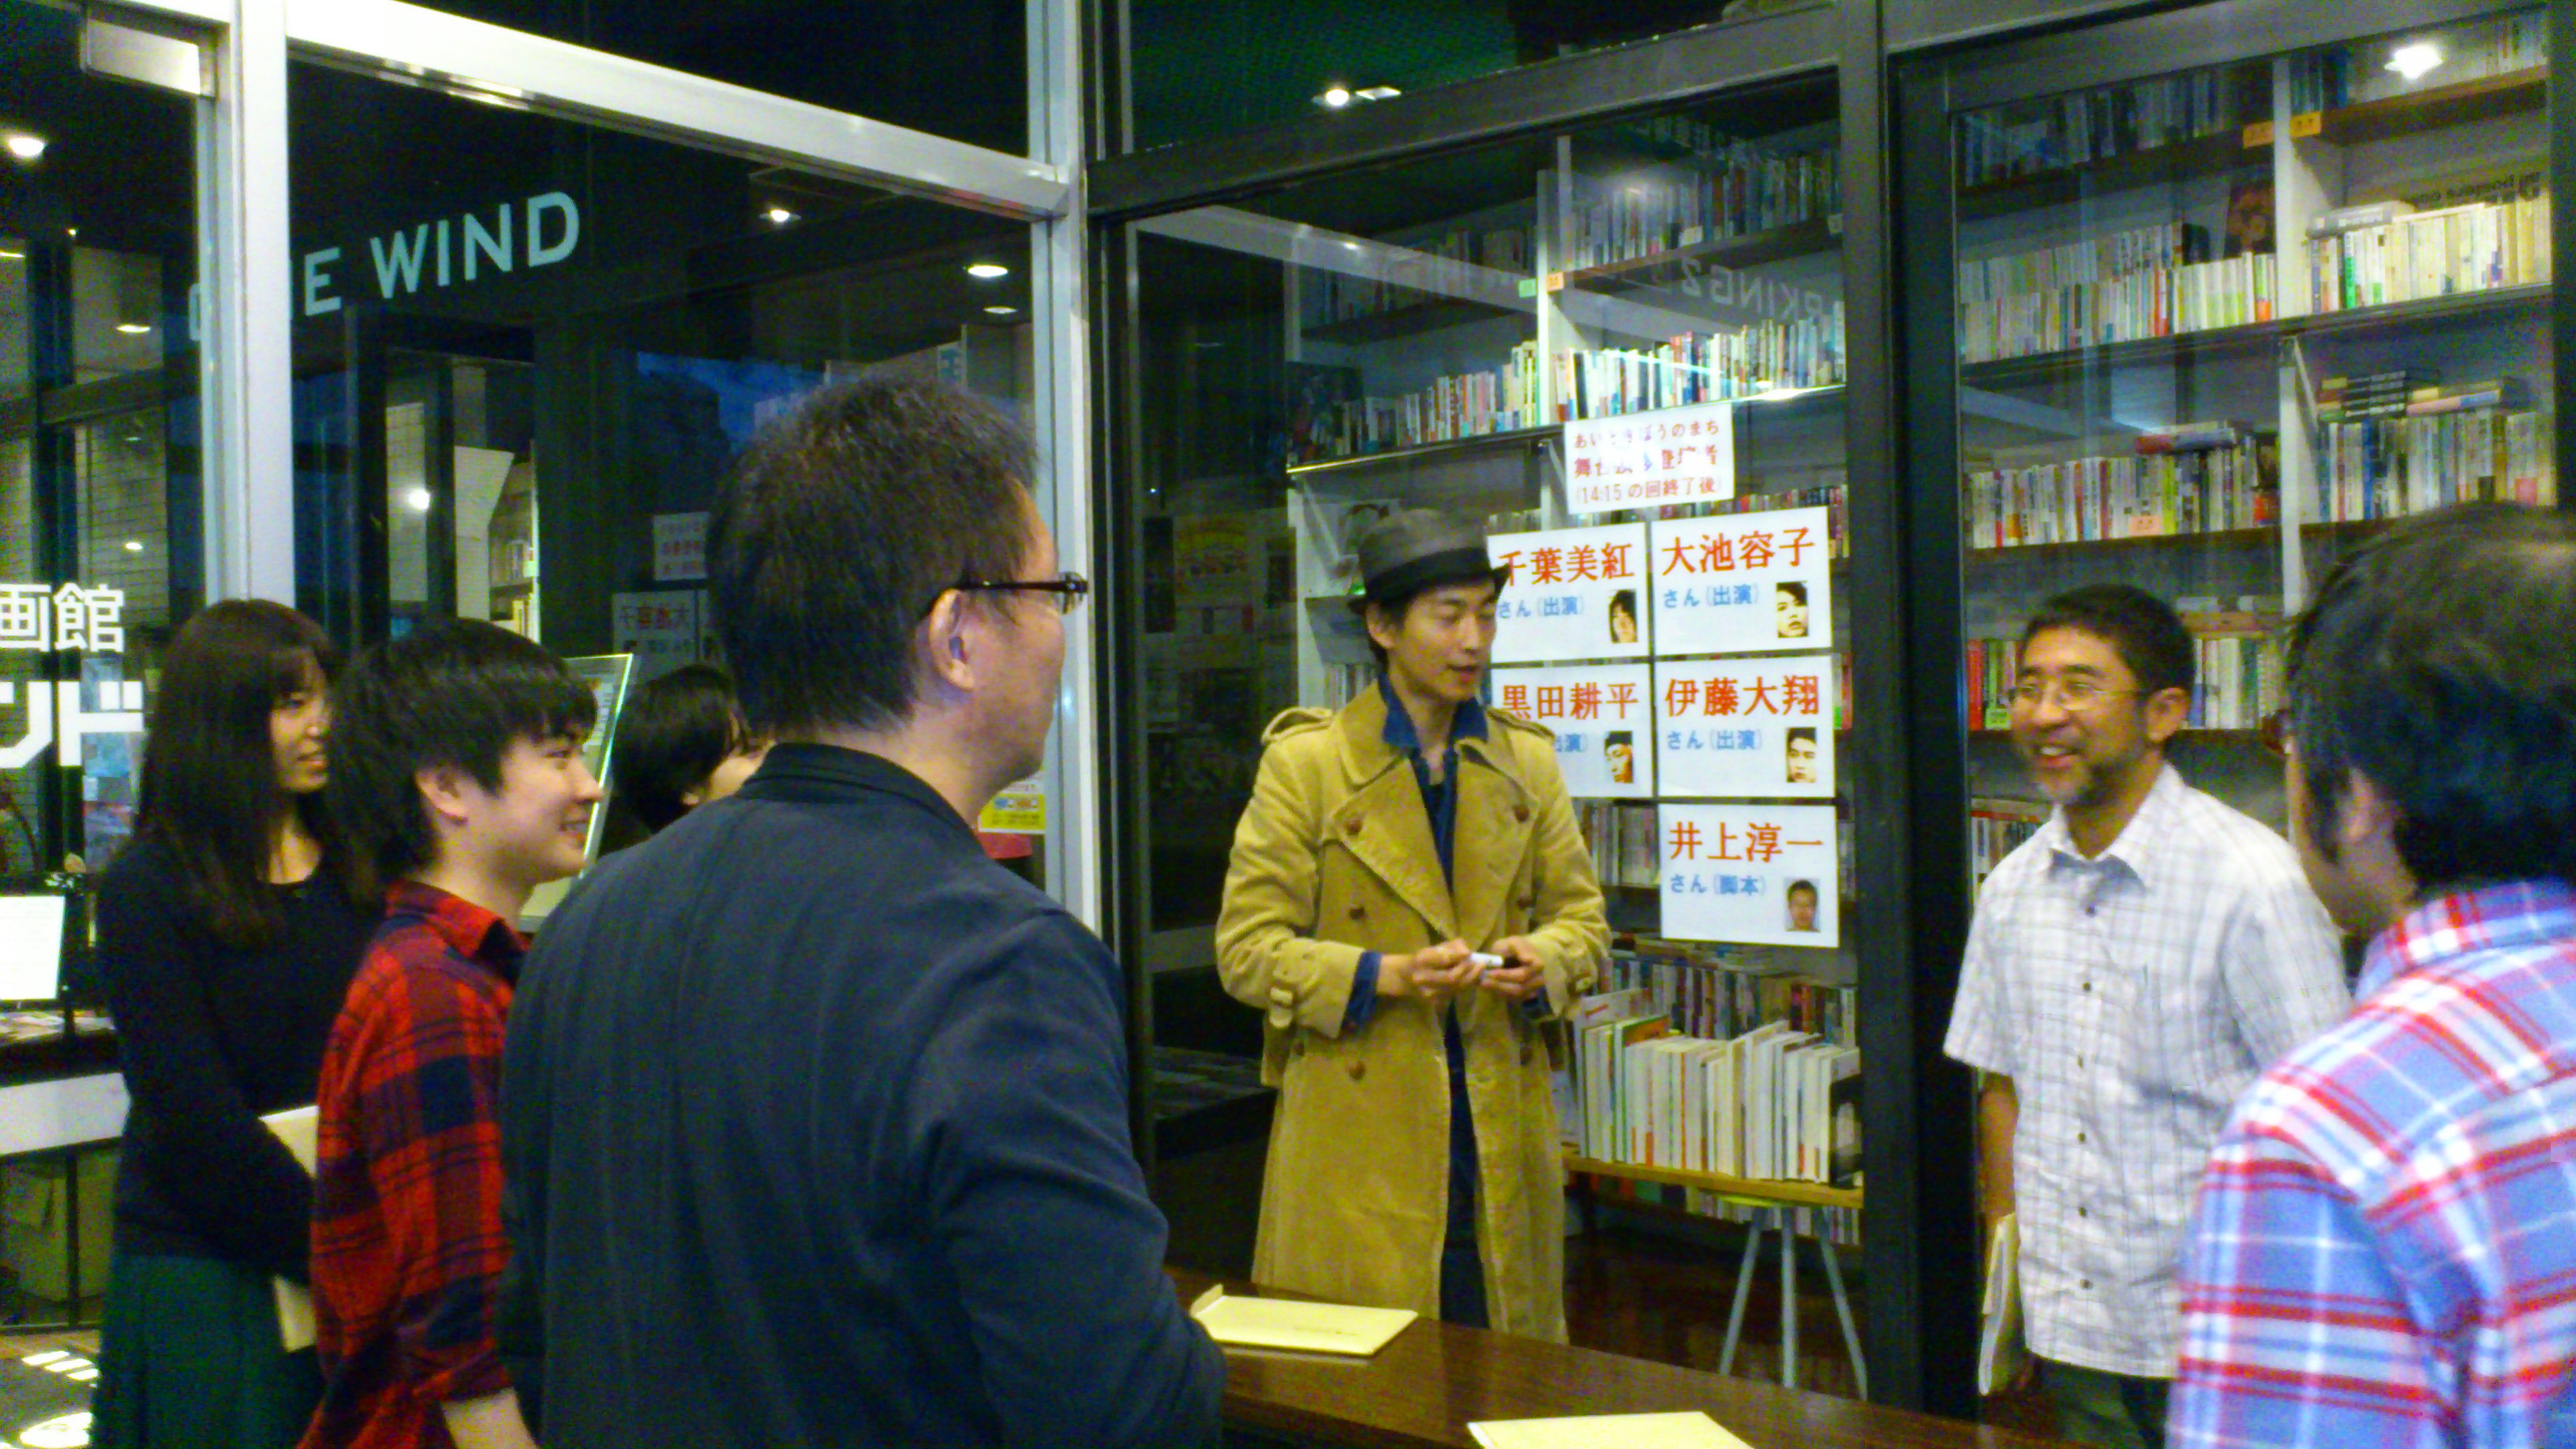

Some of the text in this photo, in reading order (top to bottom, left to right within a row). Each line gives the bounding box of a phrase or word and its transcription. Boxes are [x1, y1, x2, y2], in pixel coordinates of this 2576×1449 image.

[370, 191, 580, 299] WIND
[1498, 542, 1635, 586] 千葉美紅
[1661, 526, 1815, 576] 大池容子
[1503, 683, 1638, 721] 黒田耕平
[1665, 675, 1821, 717] 伊藤大翔
[1668, 822, 1824, 863] 井上淳一
